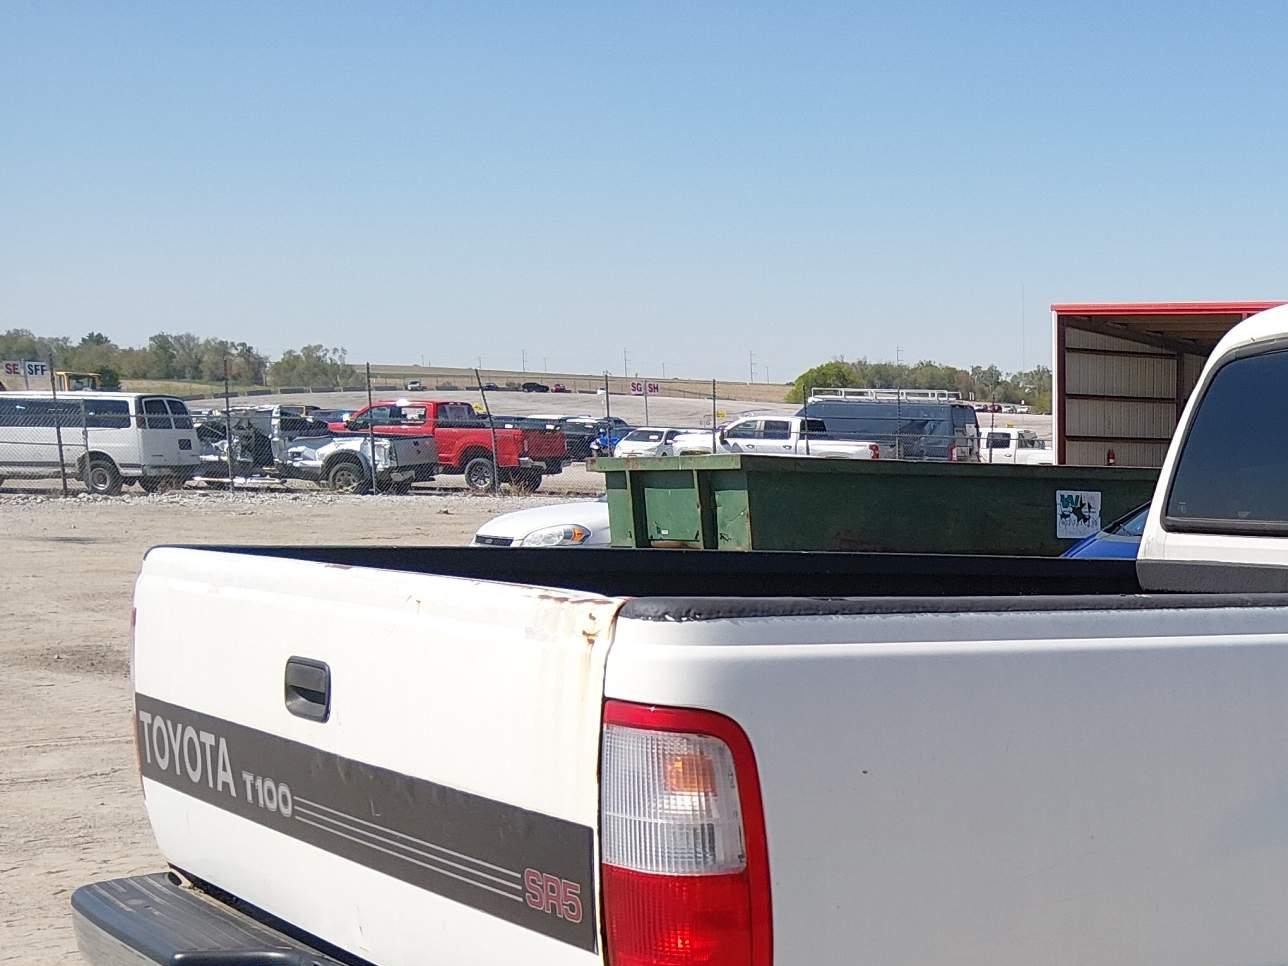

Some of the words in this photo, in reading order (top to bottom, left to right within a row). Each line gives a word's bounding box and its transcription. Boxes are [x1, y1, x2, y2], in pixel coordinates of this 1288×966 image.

[4, 362, 20, 375] SE
[27, 363, 48, 376] SFF
[631, 382, 643, 392] SG
[647, 383, 659, 393] SH
[138, 710, 237, 798] TOYOTA
[241, 770, 293, 818] T100
[524, 867, 583, 924] SR5
